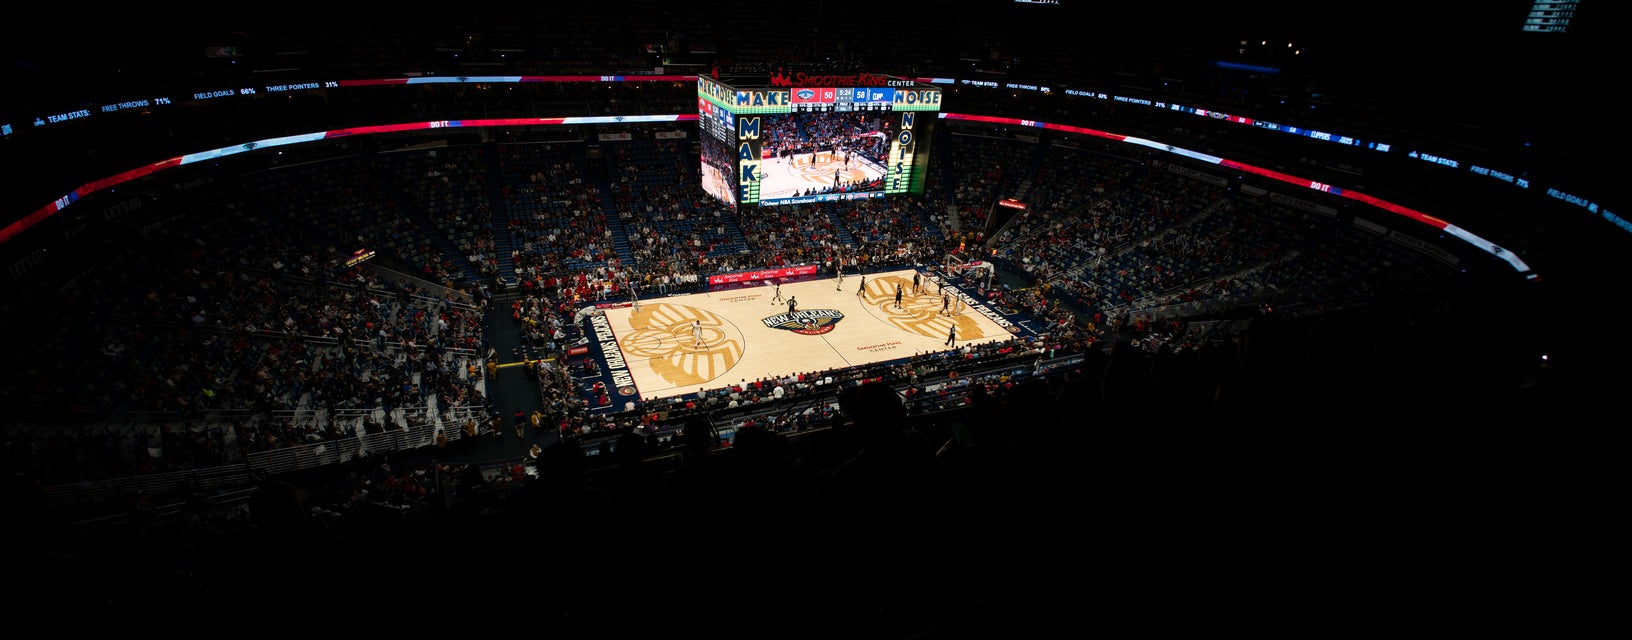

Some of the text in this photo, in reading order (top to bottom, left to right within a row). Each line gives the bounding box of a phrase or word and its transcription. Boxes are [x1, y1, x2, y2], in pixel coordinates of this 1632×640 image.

[194, 92, 213, 100] FIELD
[213, 89, 235, 98] GOALS
[266, 82, 320, 93] THREE POINTERS
[856, 91, 866, 99] 58
[101, 97, 171, 113] FREE THROWS 71%
[736, 91, 790, 106] MAKE
[895, 90, 939, 105] NOISE
[47, 113, 68, 124] TEAM
[68, 109, 91, 120] STATS:
[892, 112, 914, 191] NOISE
[1420, 153, 1438, 163] TEAM
[738, 116, 761, 204] MAKE
[1470, 165, 1490, 176] FREE
[1310, 181, 1321, 190] DO
[1321, 183, 1330, 192] IT
[55, 198, 65, 210] DO
[763, 309, 843, 327] NEW ORLEANS
[590, 315, 615, 342] PELICANS
[600, 341, 626, 370] ORLEANS
[610, 369, 634, 388] NEW
